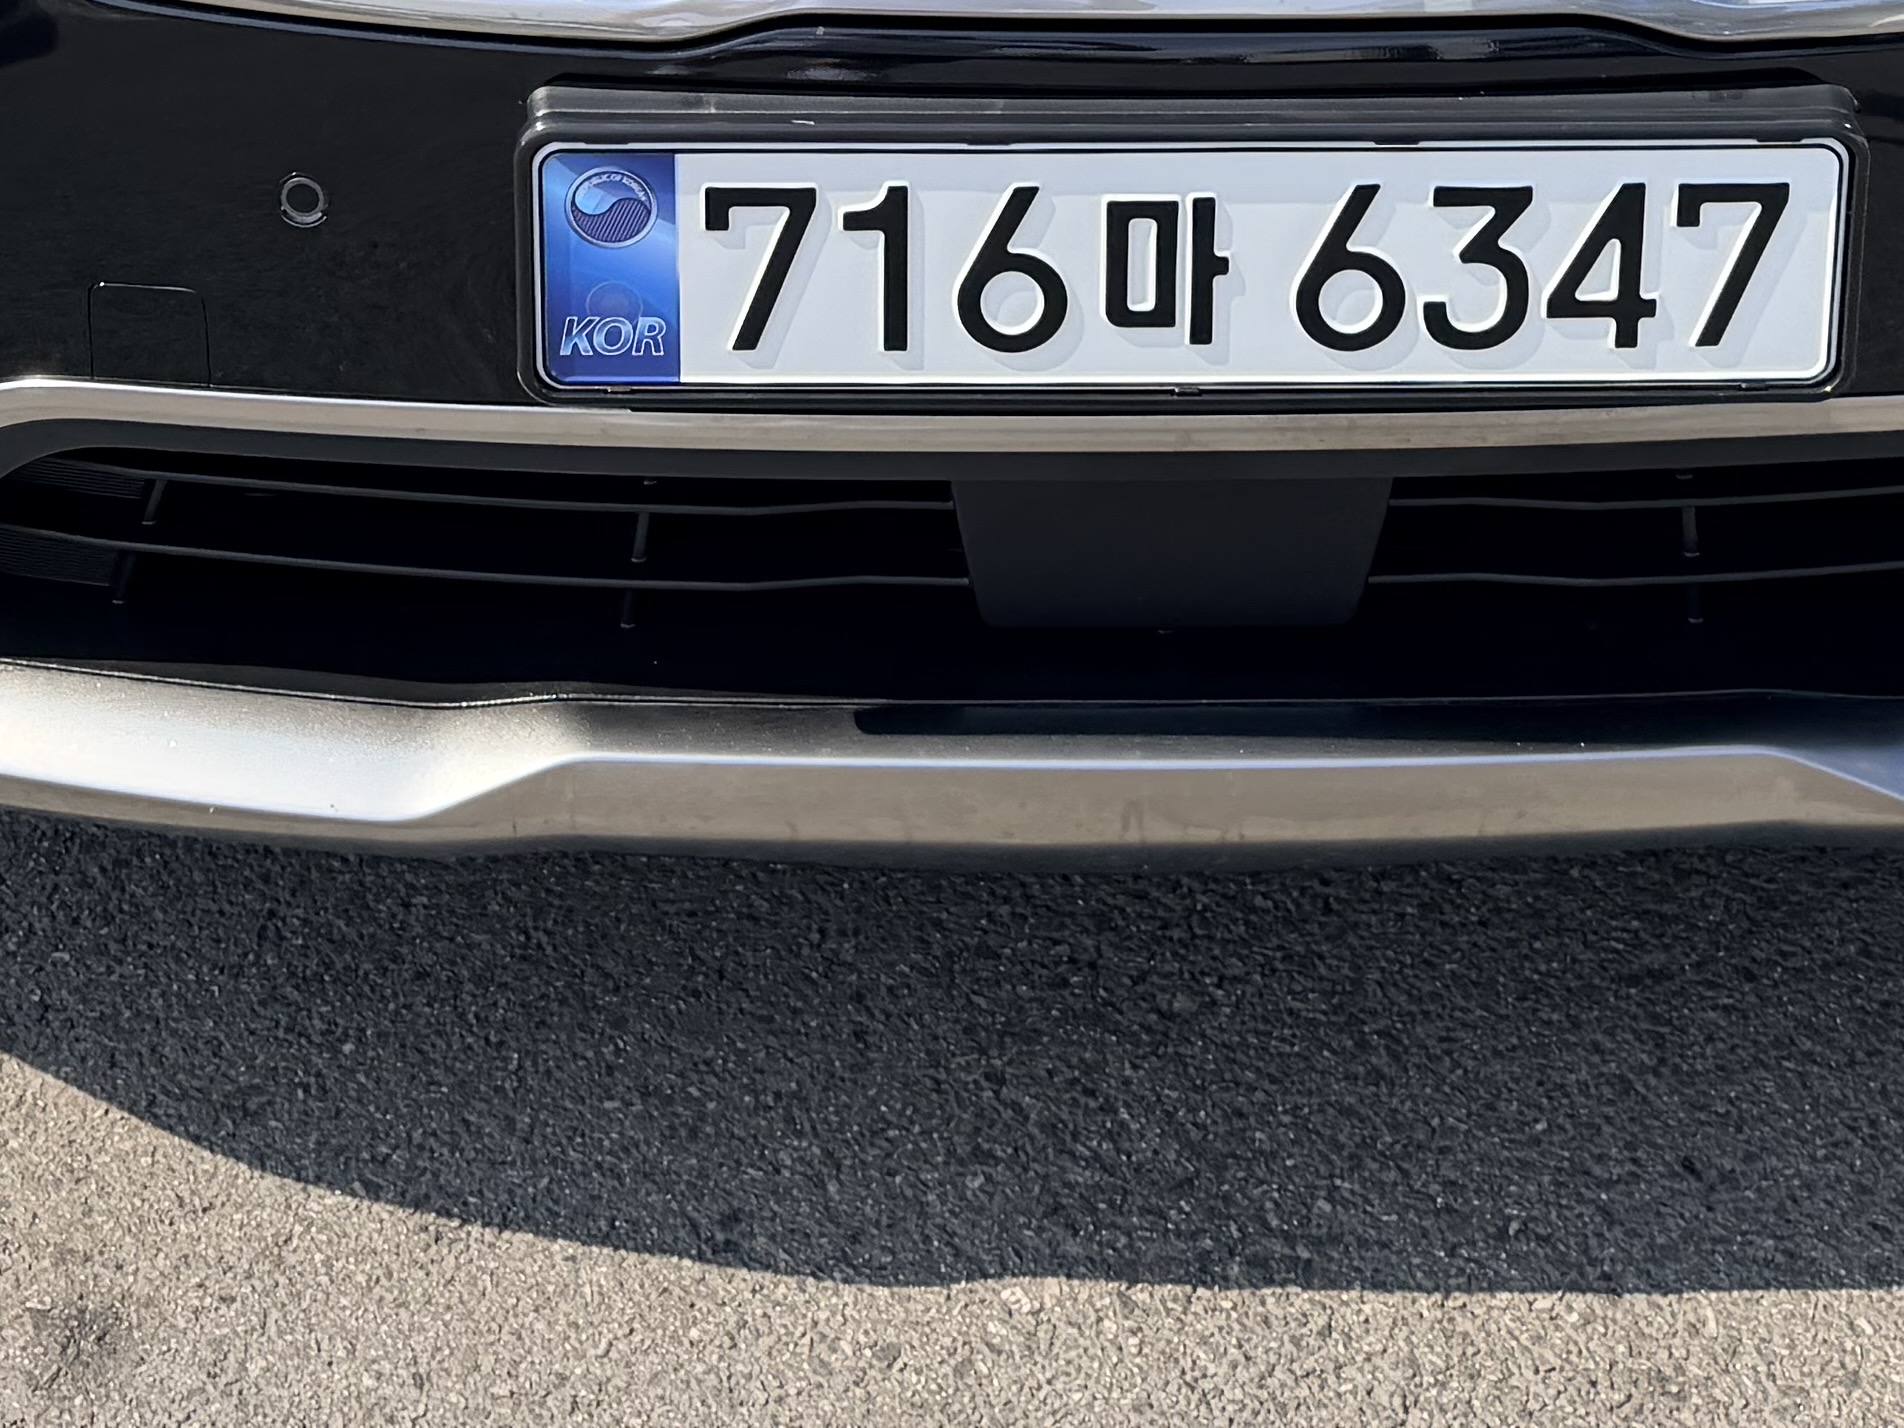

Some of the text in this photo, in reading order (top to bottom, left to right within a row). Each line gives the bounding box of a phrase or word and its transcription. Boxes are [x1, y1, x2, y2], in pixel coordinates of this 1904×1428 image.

[702, 181, 1792, 354] 716마 6347
[559, 316, 667, 356] KOR
